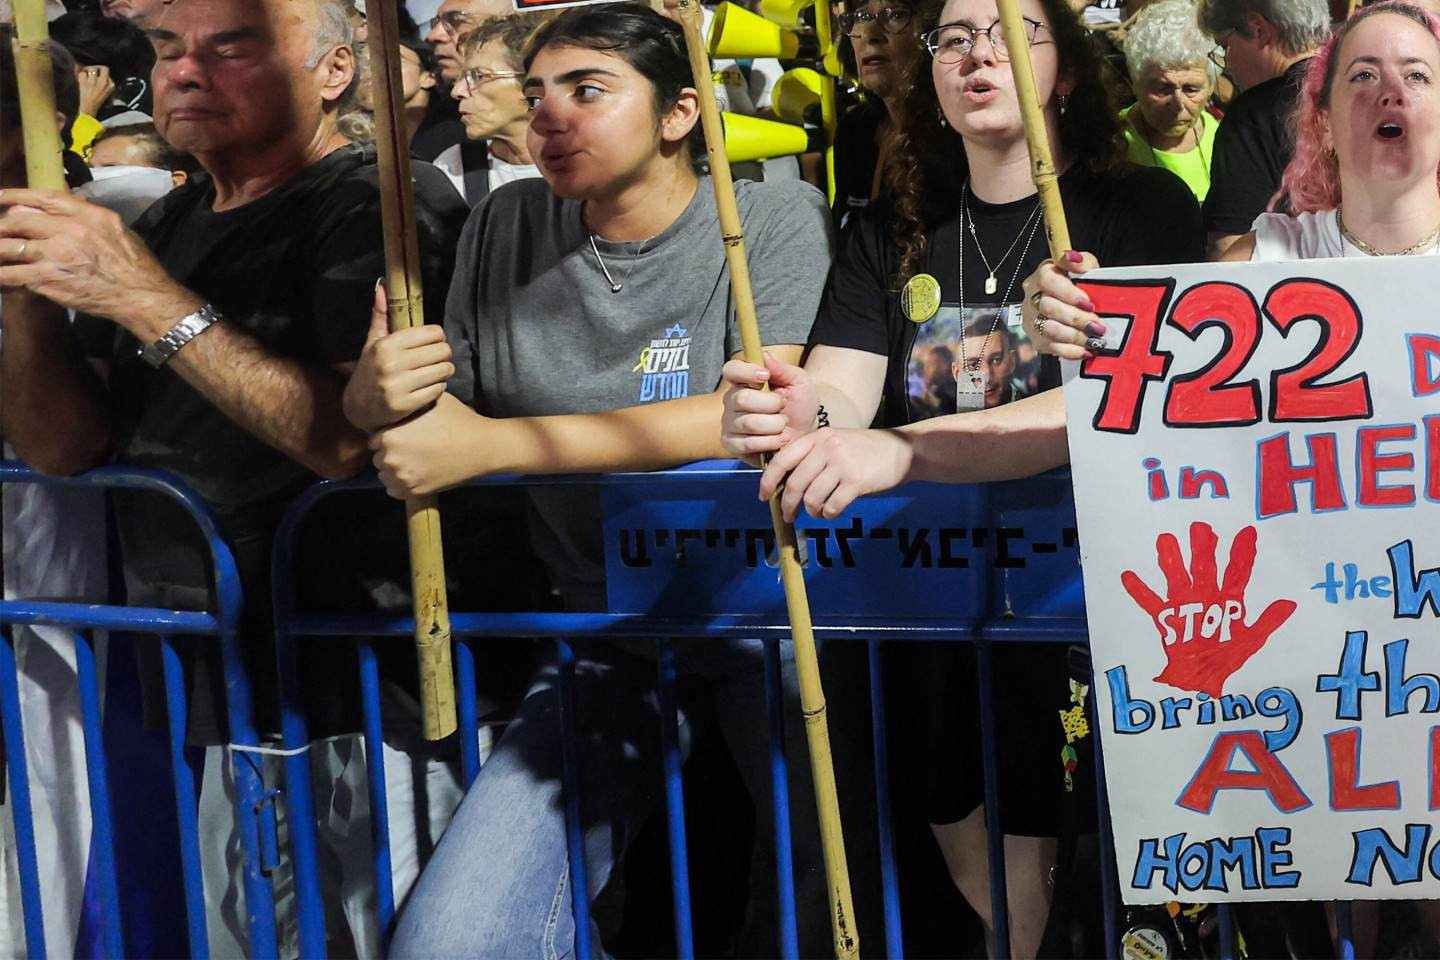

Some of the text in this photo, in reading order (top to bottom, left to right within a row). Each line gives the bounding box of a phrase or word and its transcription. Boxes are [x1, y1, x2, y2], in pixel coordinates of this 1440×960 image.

[1072, 276, 1373, 434] 722
[640, 371, 688, 401] מחדש
[1141, 456, 1231, 502] in
[1311, 563, 1392, 604] the
[1157, 599, 1244, 646] STOP
[1104, 664, 1303, 752] bring
[1131, 827, 1301, 893] HOME
